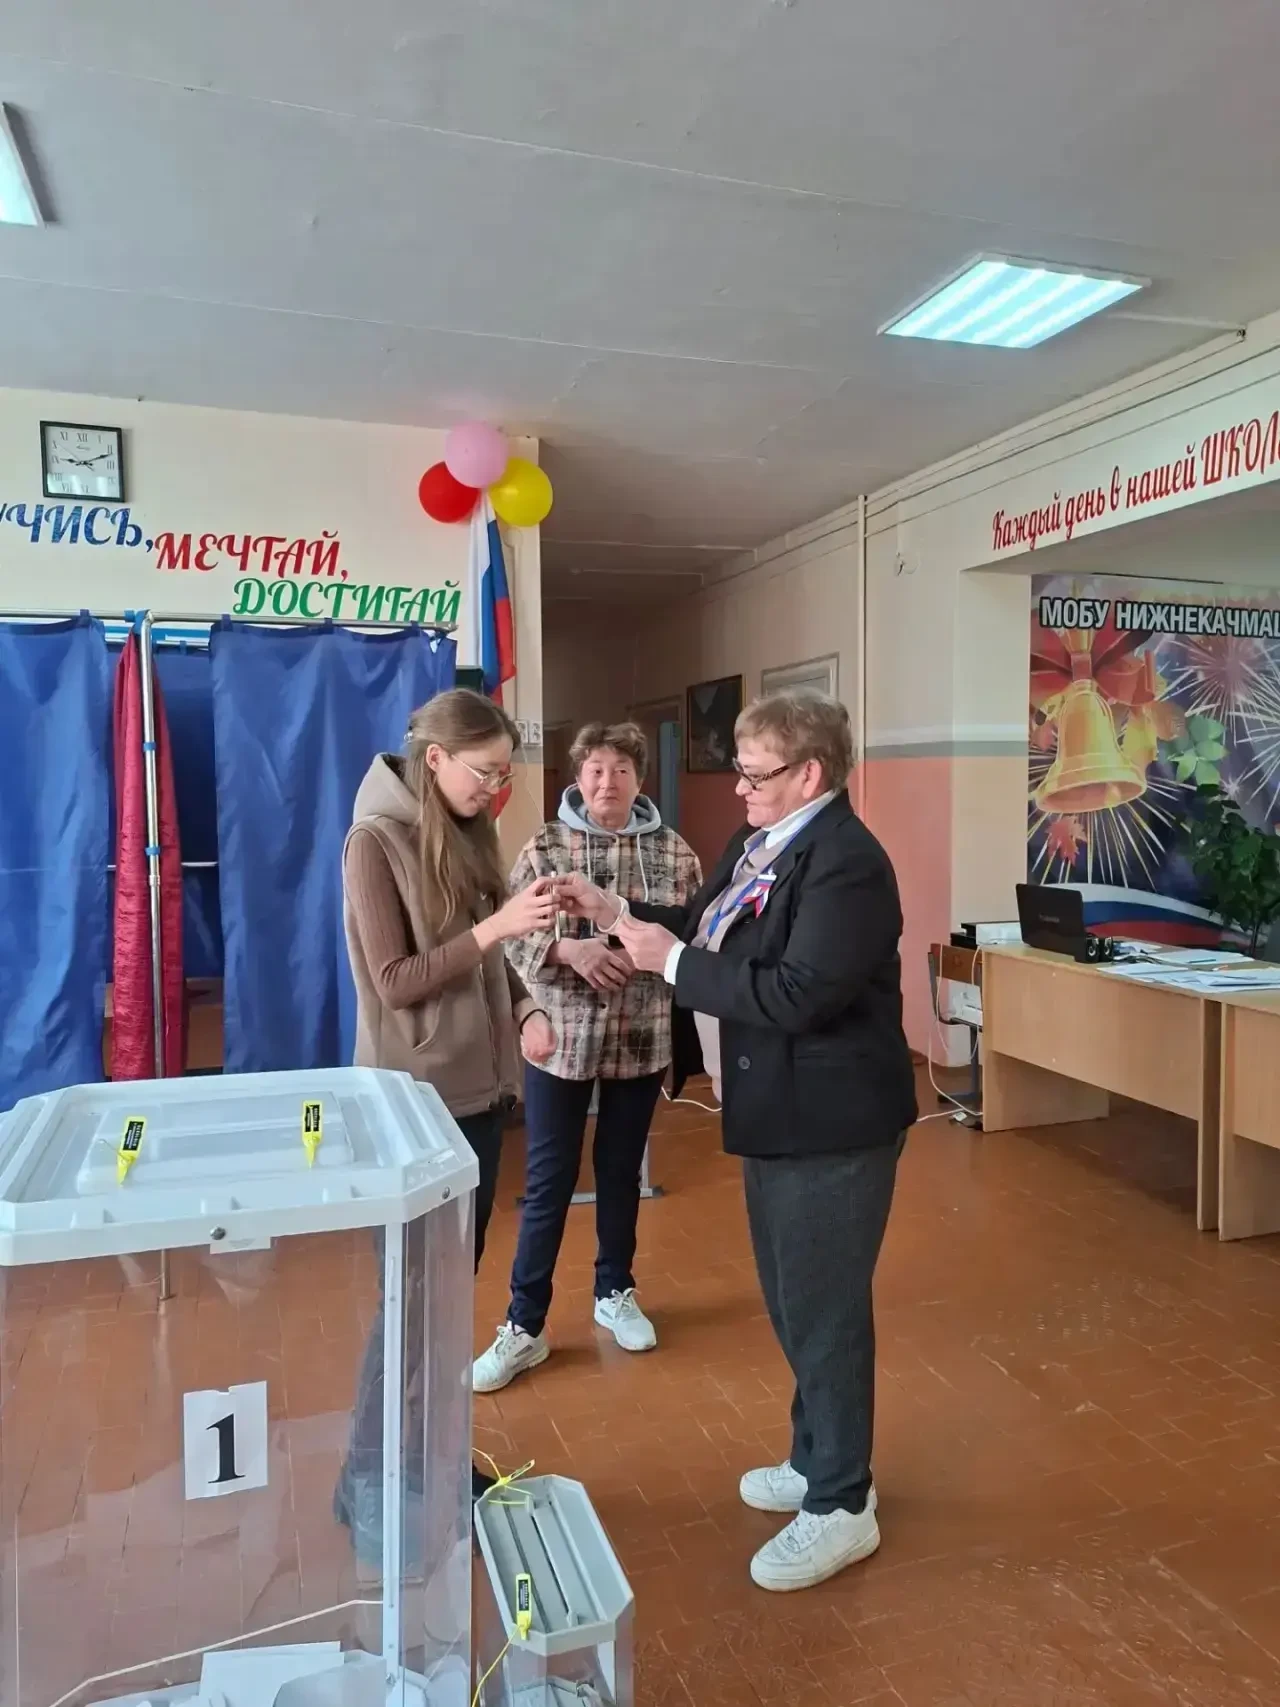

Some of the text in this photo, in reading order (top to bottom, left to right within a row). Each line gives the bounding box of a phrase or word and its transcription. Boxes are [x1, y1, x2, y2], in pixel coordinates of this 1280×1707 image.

[992, 409, 1280, 551] Каждый день в нашей ШКОЛ
[0, 503, 154, 553] ЧИСЬ,
[155, 530, 348, 583] МЕЧТАЙ,
[233, 577, 462, 623] ДОСТИГАЙ
[1040, 598, 1280, 637] МОБУ НИЖНЕКАЧМА
[206, 1413, 245, 1484] 1
